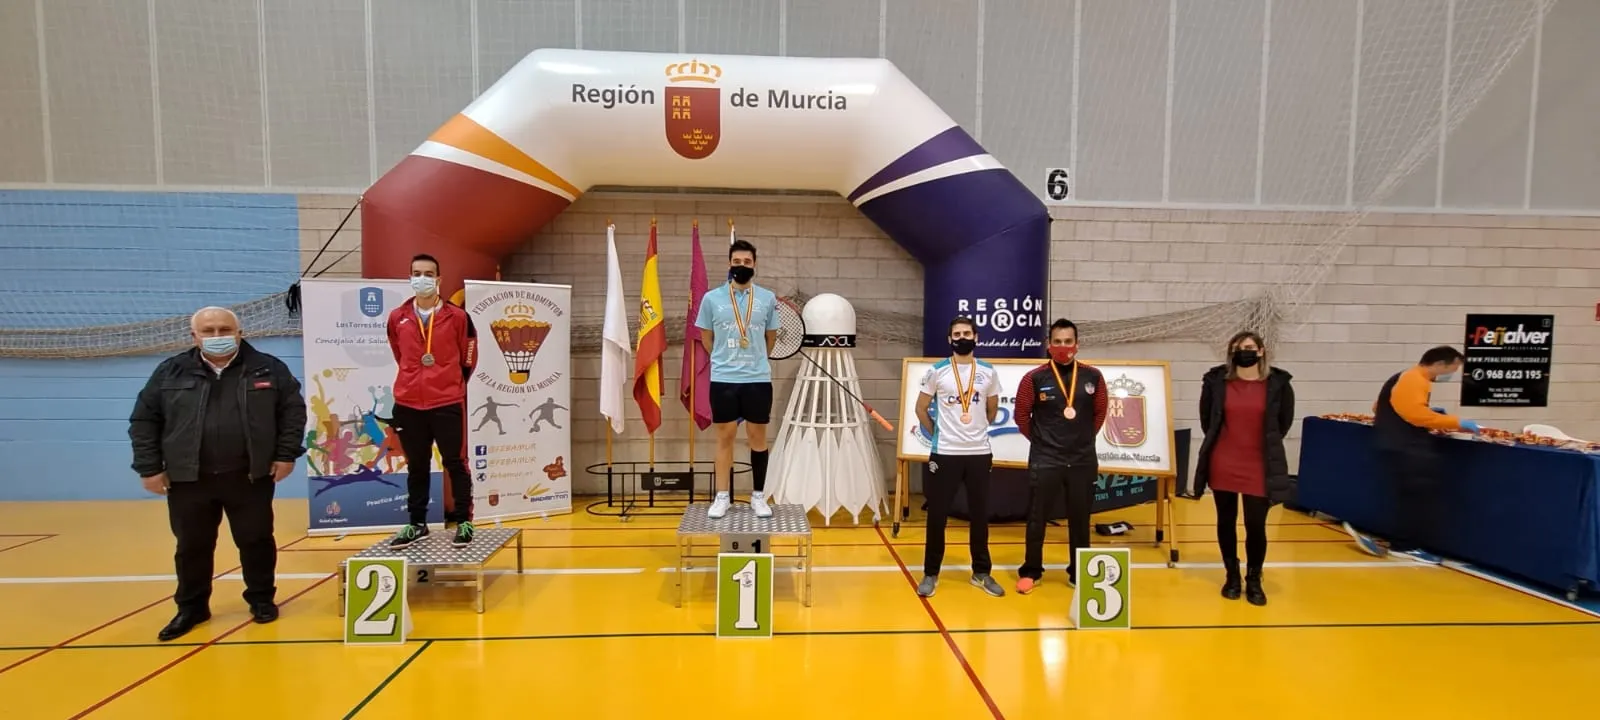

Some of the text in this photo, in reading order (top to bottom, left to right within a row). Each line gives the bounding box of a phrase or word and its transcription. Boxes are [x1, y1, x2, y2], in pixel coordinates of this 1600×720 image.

[572, 83, 847, 110] Región de Murcia
[1047, 169, 1068, 200] 6
[958, 295, 1042, 311] REGIÓN
[958, 312, 1042, 331] URCIA
[1472, 323, 1550, 345] Peñalver
[1486, 370, 1542, 380] 968 623 195
[417, 569, 429, 583] 2
[1086, 554, 1124, 622] 3
[354, 563, 398, 636] 2
[732, 559, 760, 630] 1
